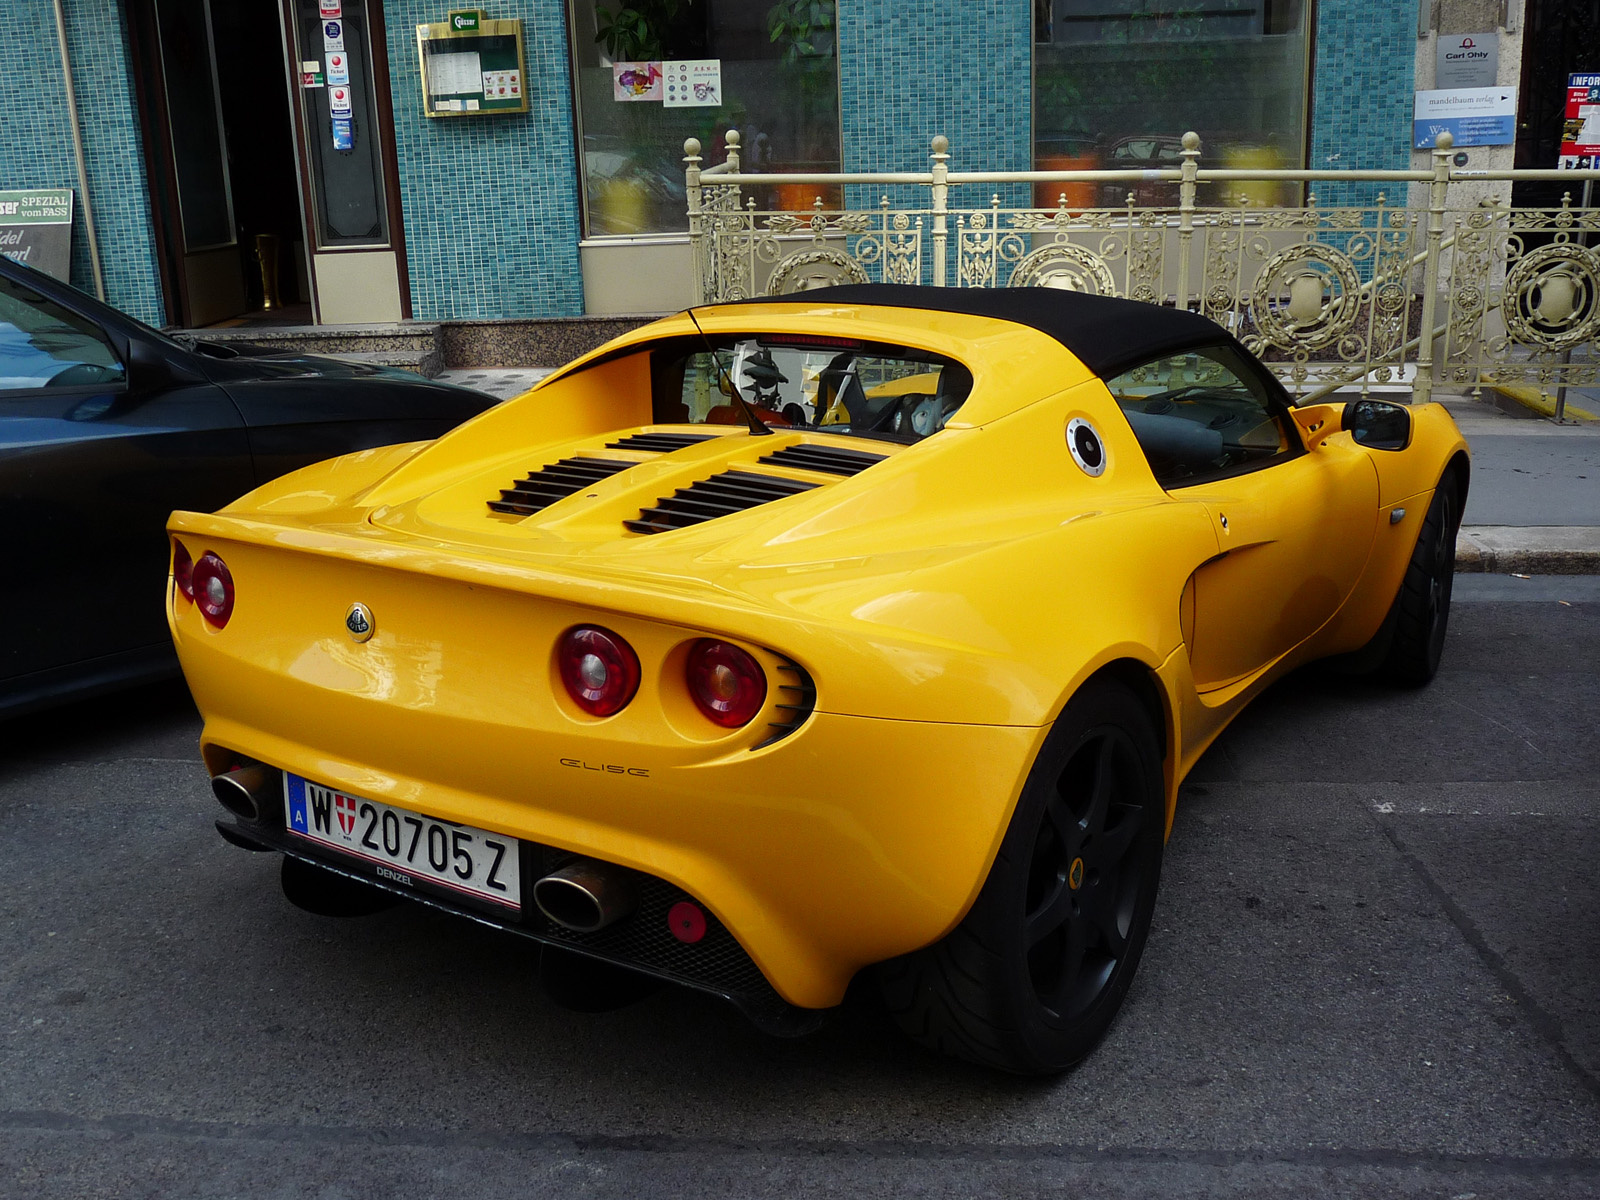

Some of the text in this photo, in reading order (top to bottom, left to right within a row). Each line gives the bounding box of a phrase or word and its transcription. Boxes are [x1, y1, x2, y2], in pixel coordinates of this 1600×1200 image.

[1428, 94, 1495, 105] mandelbaum verlag
[21, 196, 68, 207] SPEZIAL
[43, 207, 68, 217] FASS
[0, 229, 25, 245] del
[559, 758, 650, 778] ELISE
[295, 810, 304, 825] A
[309, 785, 507, 892] W 20705 Z
[376, 865, 414, 887] DENZEL
